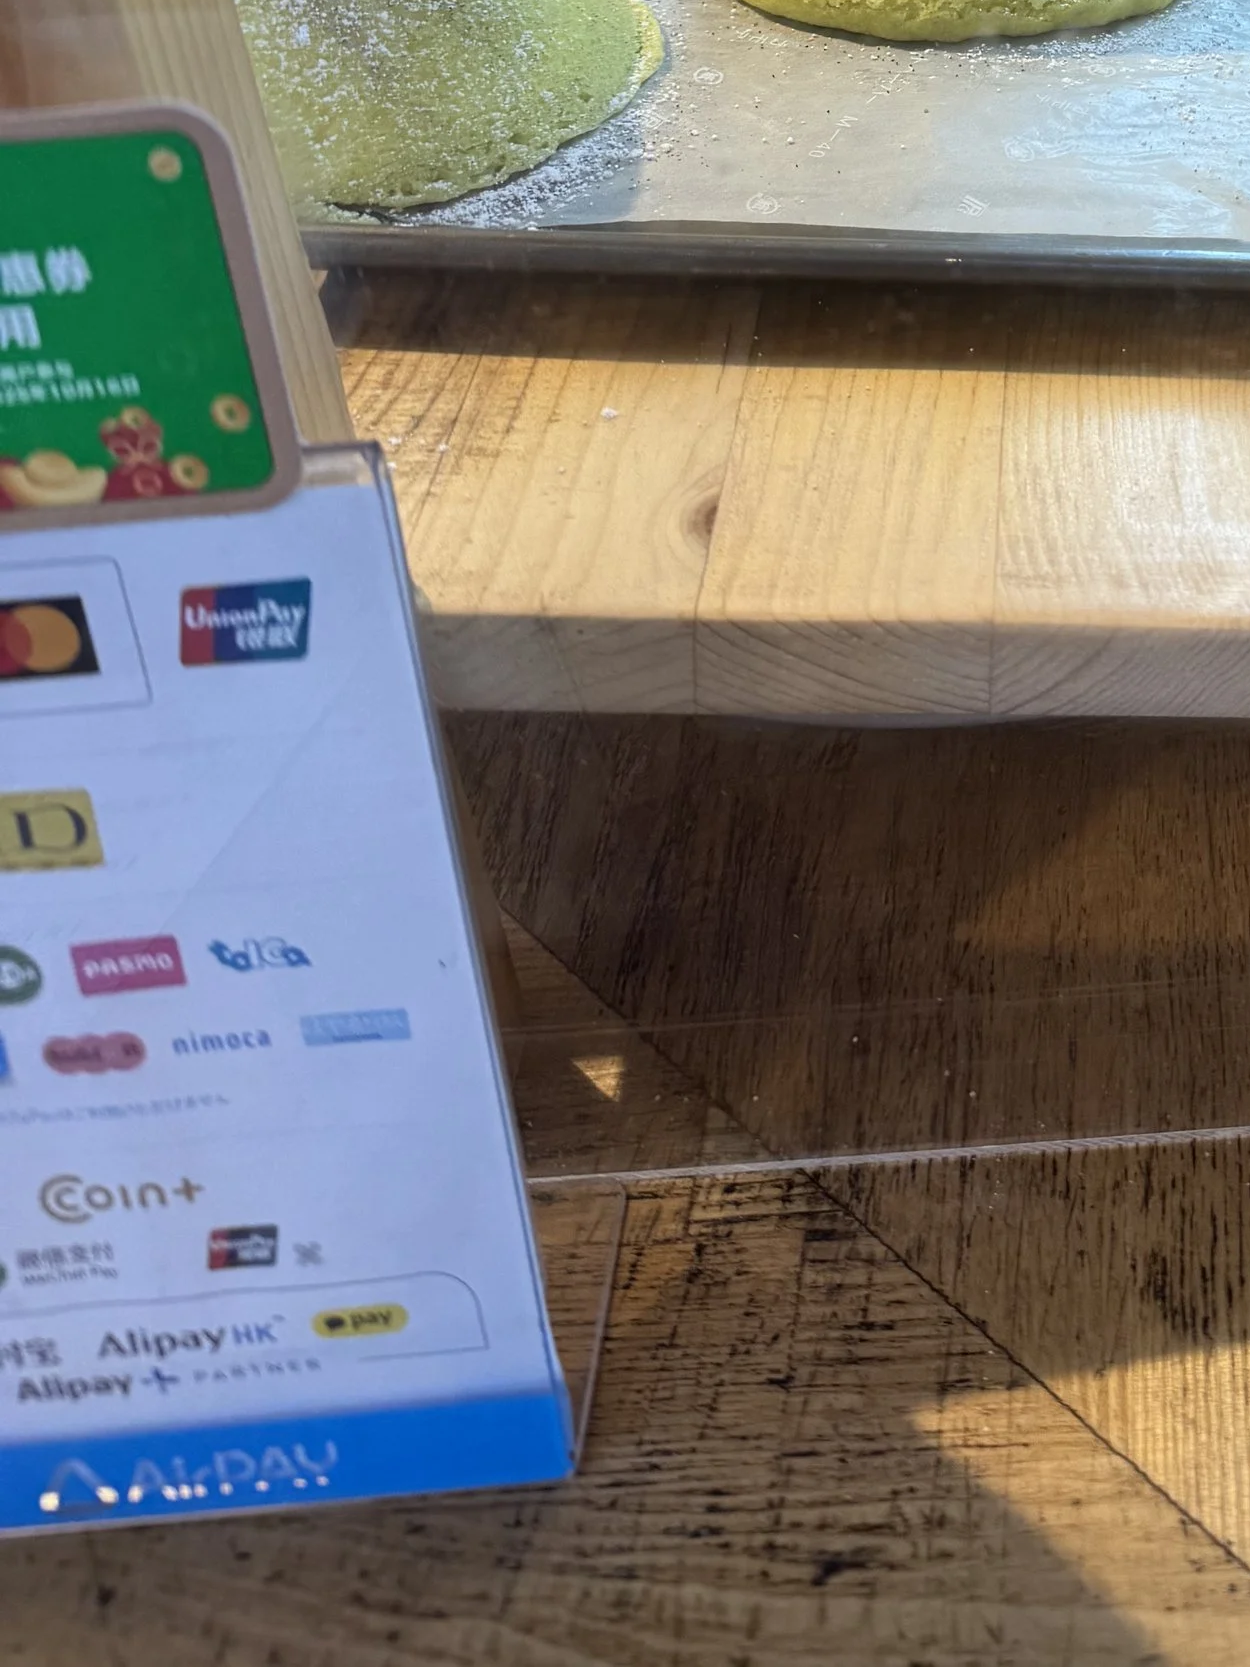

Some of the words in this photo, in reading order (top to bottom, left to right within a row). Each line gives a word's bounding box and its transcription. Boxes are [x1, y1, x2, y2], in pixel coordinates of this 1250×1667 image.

[184, 597, 306, 636] UnionPay
[83, 952, 173, 980] PASMO
[172, 1030, 272, 1056] nimoca
[38, 1174, 204, 1223] Coin+
[349, 1311, 393, 1331] pay
[193, 1356, 321, 1382] PARTNER
